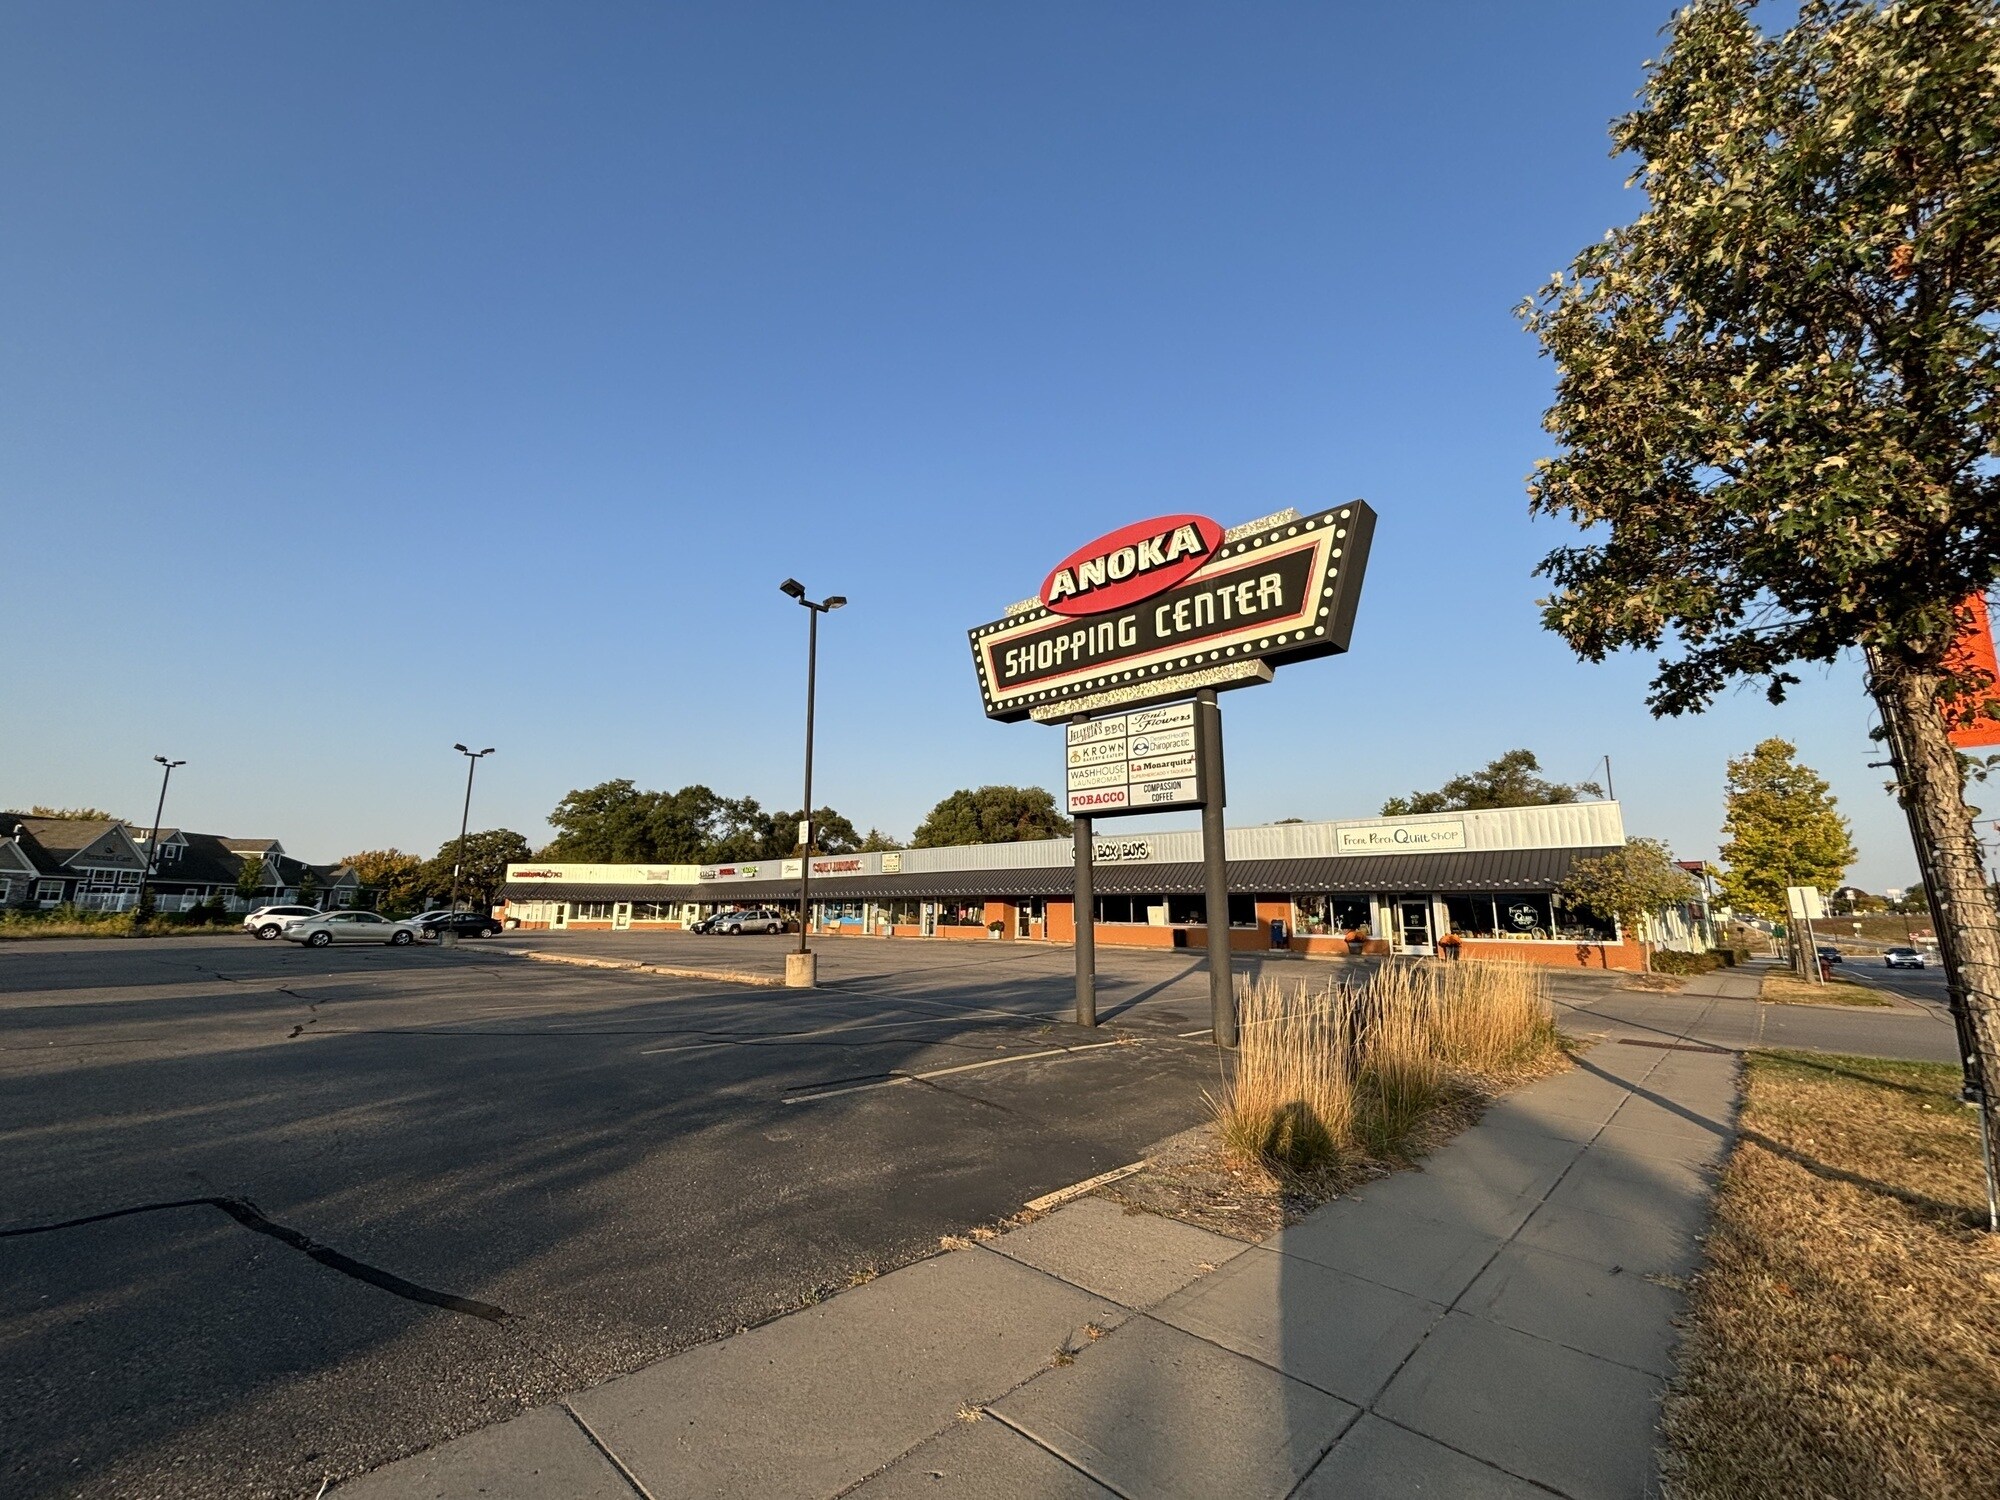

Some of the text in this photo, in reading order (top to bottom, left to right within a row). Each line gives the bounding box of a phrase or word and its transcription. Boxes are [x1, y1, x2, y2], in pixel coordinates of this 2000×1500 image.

[1048, 523, 1206, 602] ANOKA
[1004, 572, 1283, 678] SHOPPING CENTER
[1131, 710, 1167, 724] Toni's
[1135, 714, 1191, 732] Flowers
[1104, 723, 1125, 736] BBQ
[1083, 742, 1124, 757] KROWN
[1150, 739, 1190, 751] Chiropractic
[1070, 764, 1126, 779] WASHHOUSE
[1130, 758, 1192, 772] La Monarquita
[1074, 775, 1122, 787] LAUNDROMAT
[1144, 781, 1182, 792] COMPASSION
[1071, 792, 1125, 806] TOBACCO
[1152, 792, 1174, 802] COFFEE
[1344, 834, 1367, 845] Front
[1370, 832, 1394, 844] Porch
[1097, 844, 1118, 860] BOX
[1121, 841, 1148, 859] BUYS
